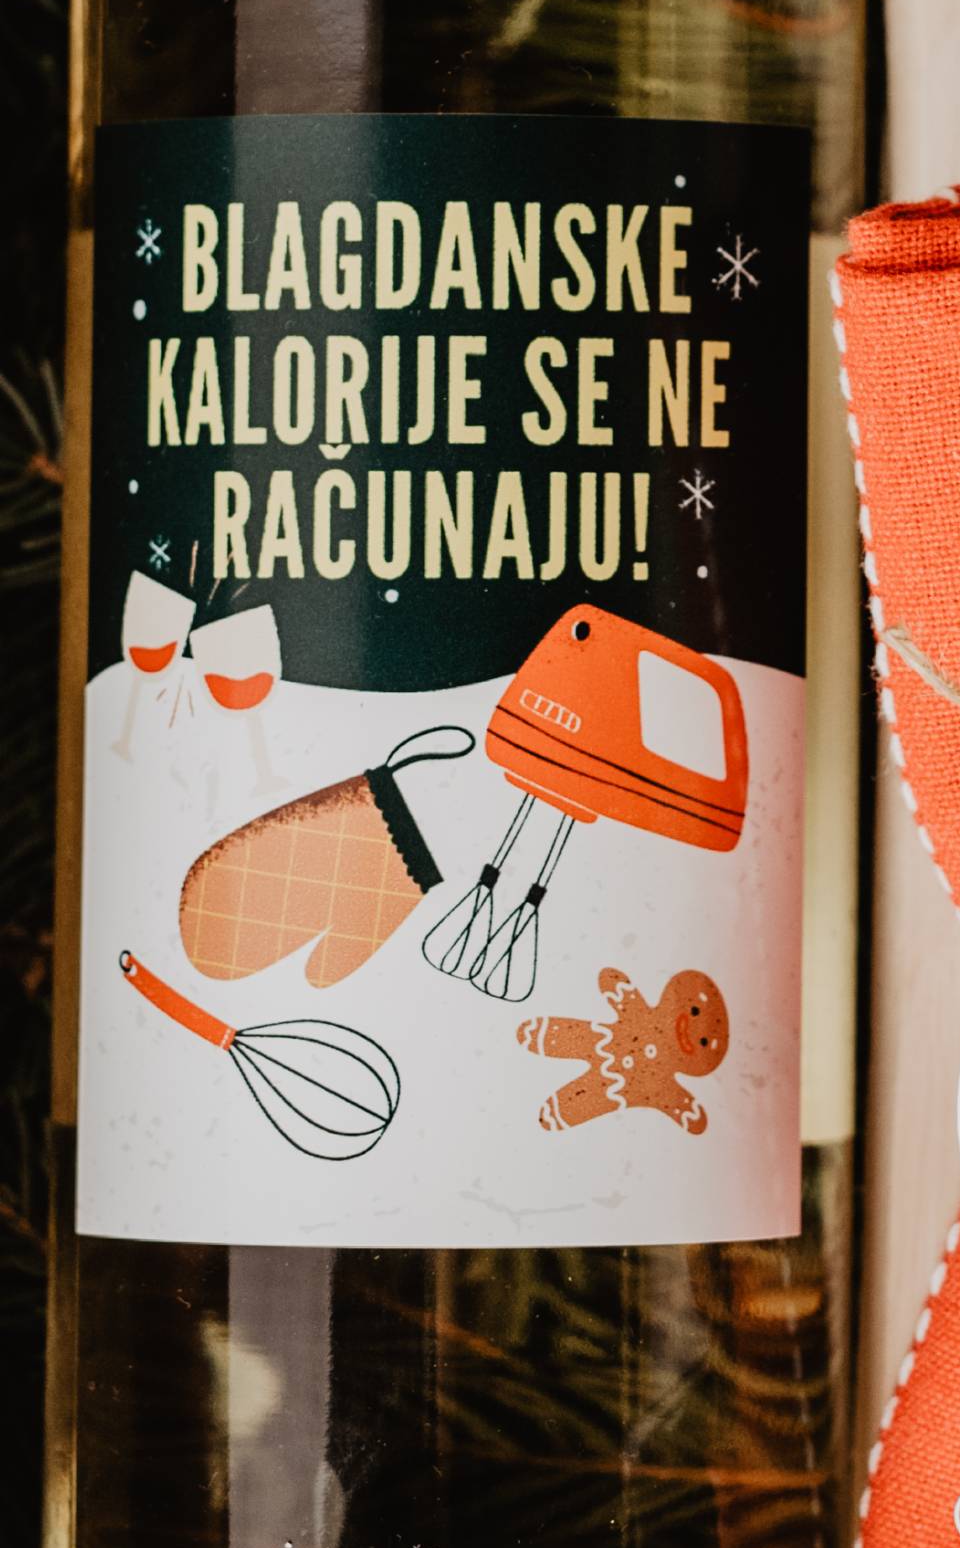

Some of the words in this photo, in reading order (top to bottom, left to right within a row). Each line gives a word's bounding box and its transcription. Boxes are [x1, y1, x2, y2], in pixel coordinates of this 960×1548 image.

[181, 202, 693, 314] BLAGDANSKE
[147, 335, 488, 447] KALORIJE
[522, 337, 614, 447] SE
[648, 339, 730, 448] NE
[212, 446, 651, 582] RAČUNAJU!
